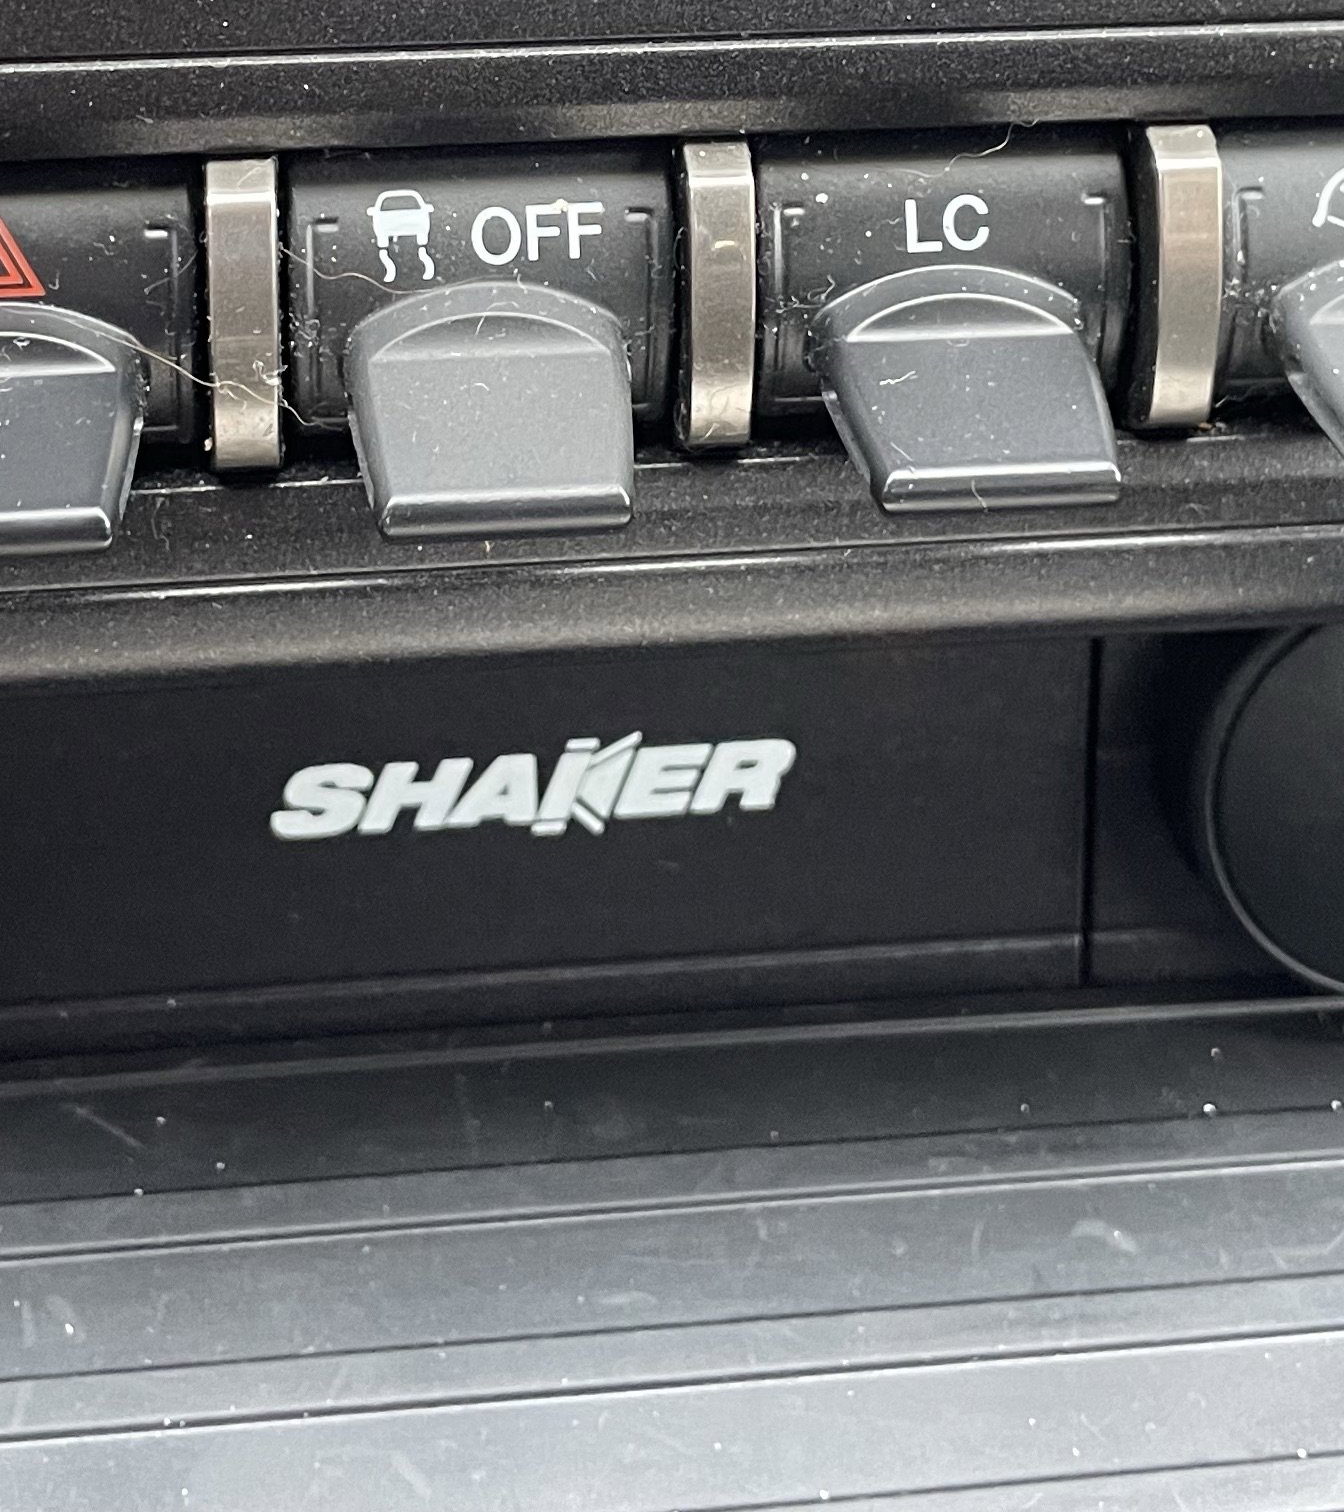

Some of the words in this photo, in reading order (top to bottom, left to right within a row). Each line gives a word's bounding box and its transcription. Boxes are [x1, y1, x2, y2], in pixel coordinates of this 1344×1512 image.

[470, 199, 605, 266] OFF
[904, 194, 990, 254] LC
[271, 732, 797, 838] SHAKER
